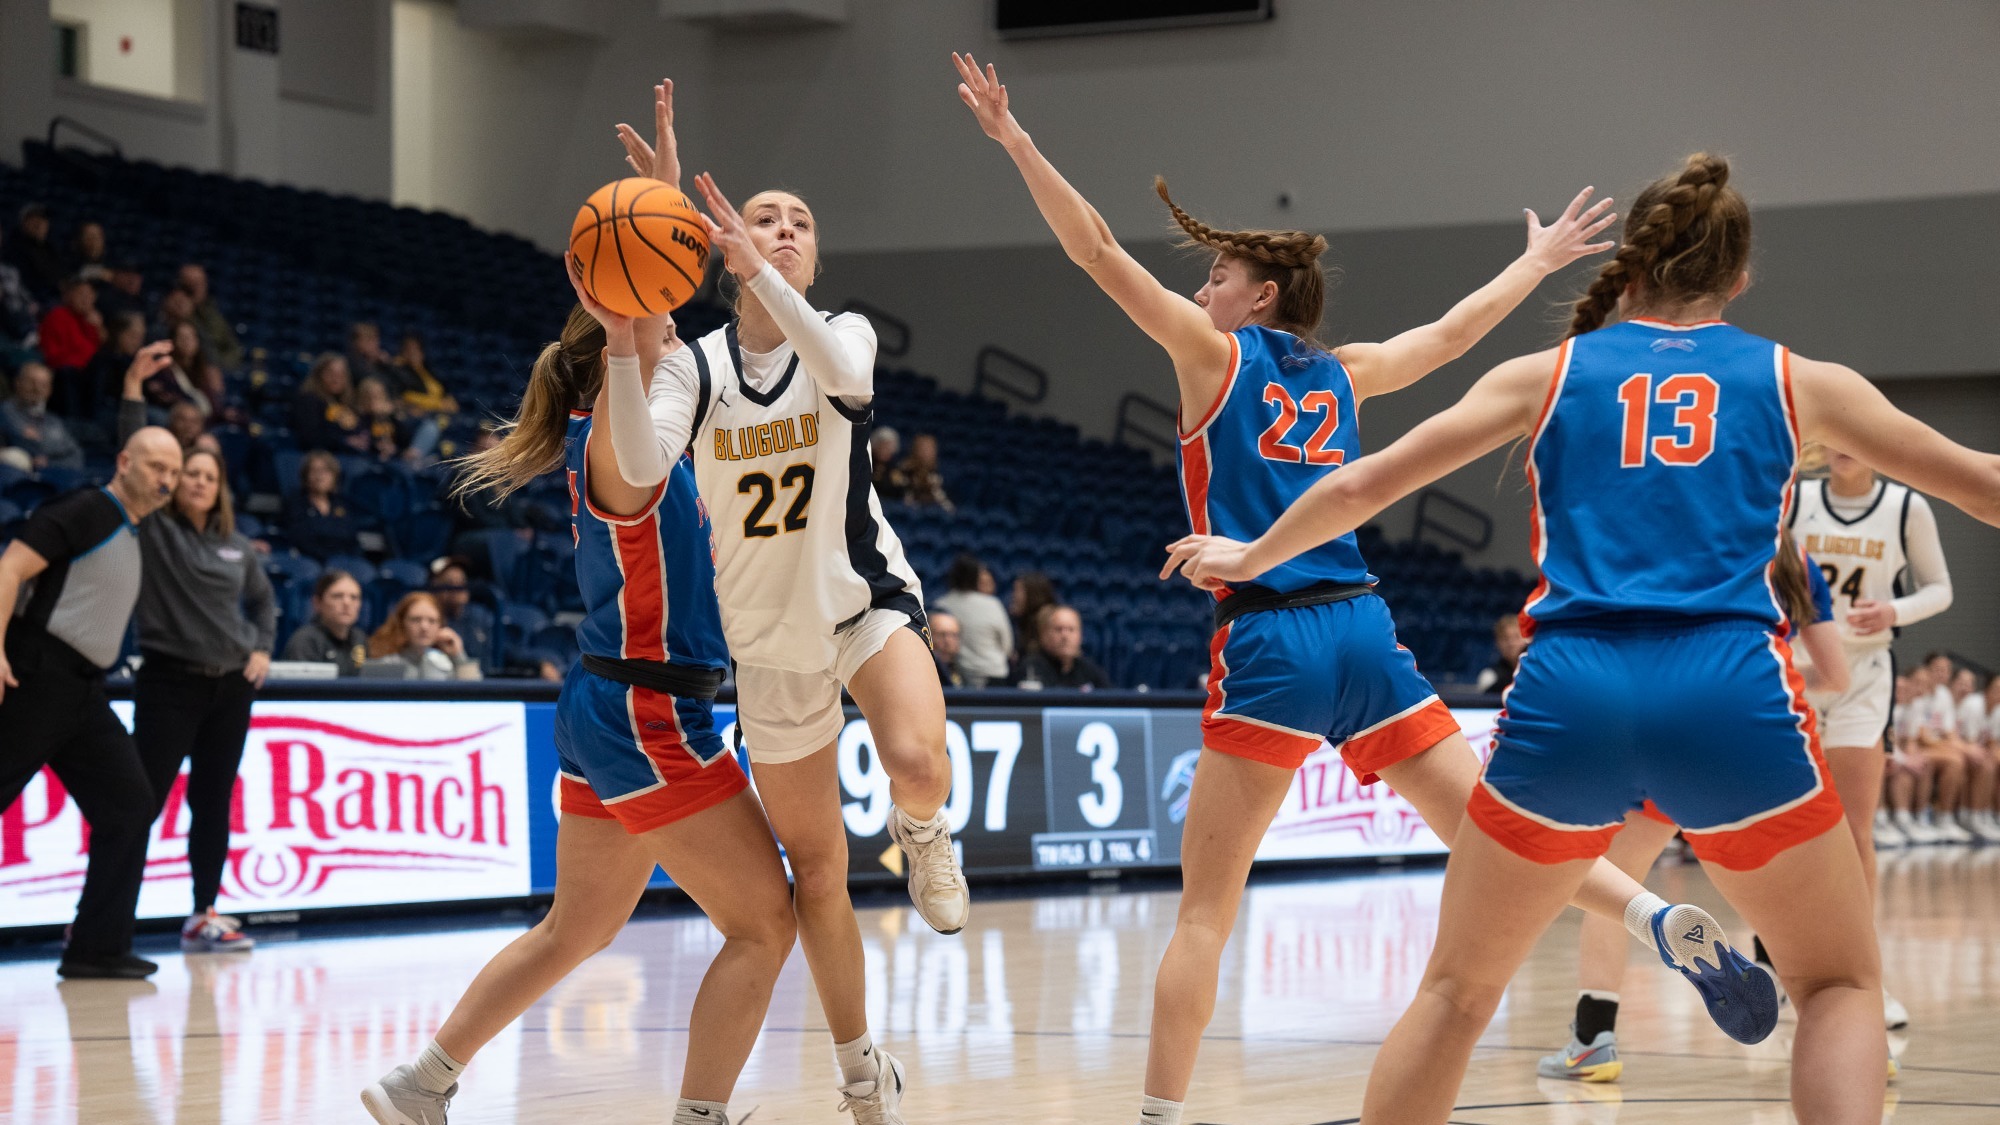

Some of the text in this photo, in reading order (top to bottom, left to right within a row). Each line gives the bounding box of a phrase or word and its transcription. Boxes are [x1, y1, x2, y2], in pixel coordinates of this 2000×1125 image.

[1258, 381, 1345, 466] 22
[1617, 372, 1721, 468] 13
[737, 462, 816, 539] 22
[265, 740, 508, 847] Ranch
[1076, 722, 1123, 828] 3
